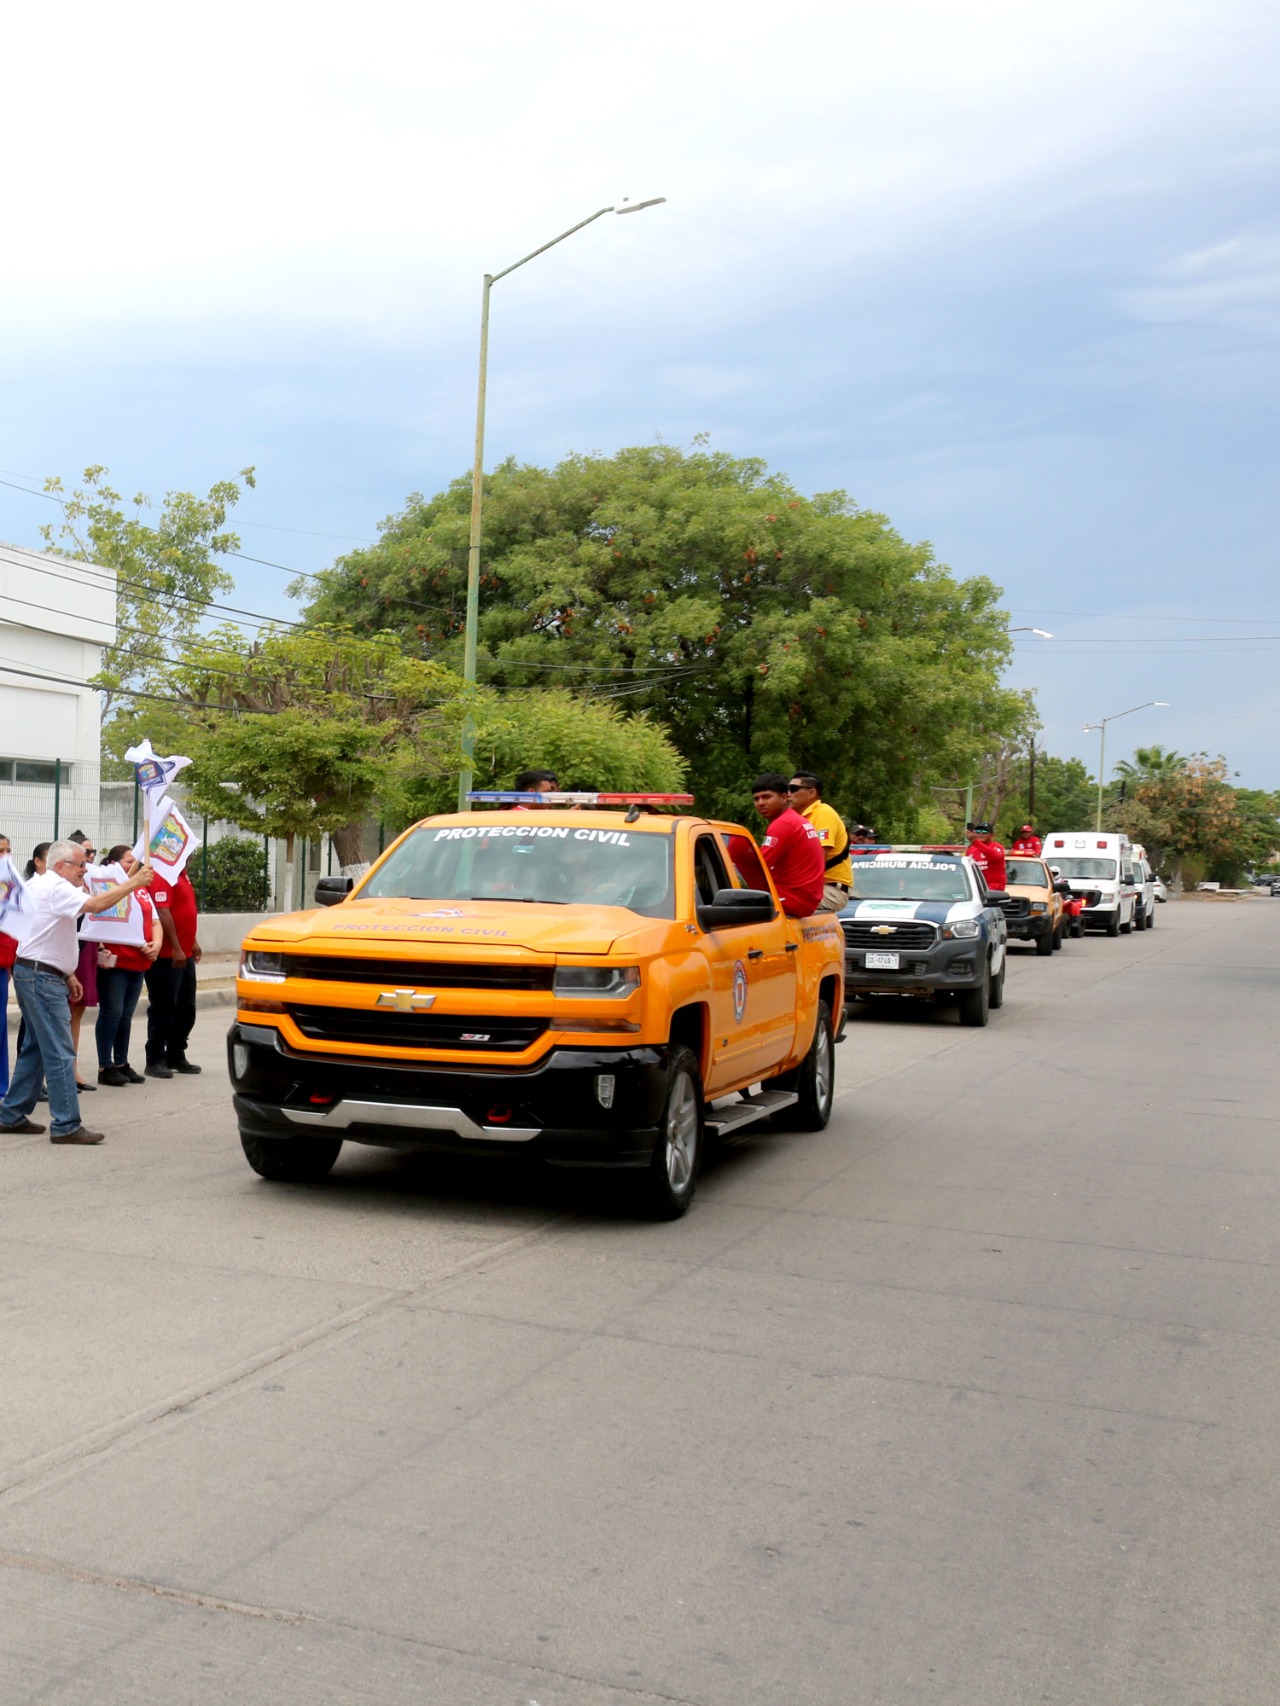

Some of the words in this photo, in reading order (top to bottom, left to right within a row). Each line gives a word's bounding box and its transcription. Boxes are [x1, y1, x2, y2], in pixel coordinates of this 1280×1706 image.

[433, 826, 570, 842] PROTECCION
[573, 829, 631, 847] CIVIL
[331, 923, 456, 933] PROTECCION
[459, 927, 512, 938] CIVIL
